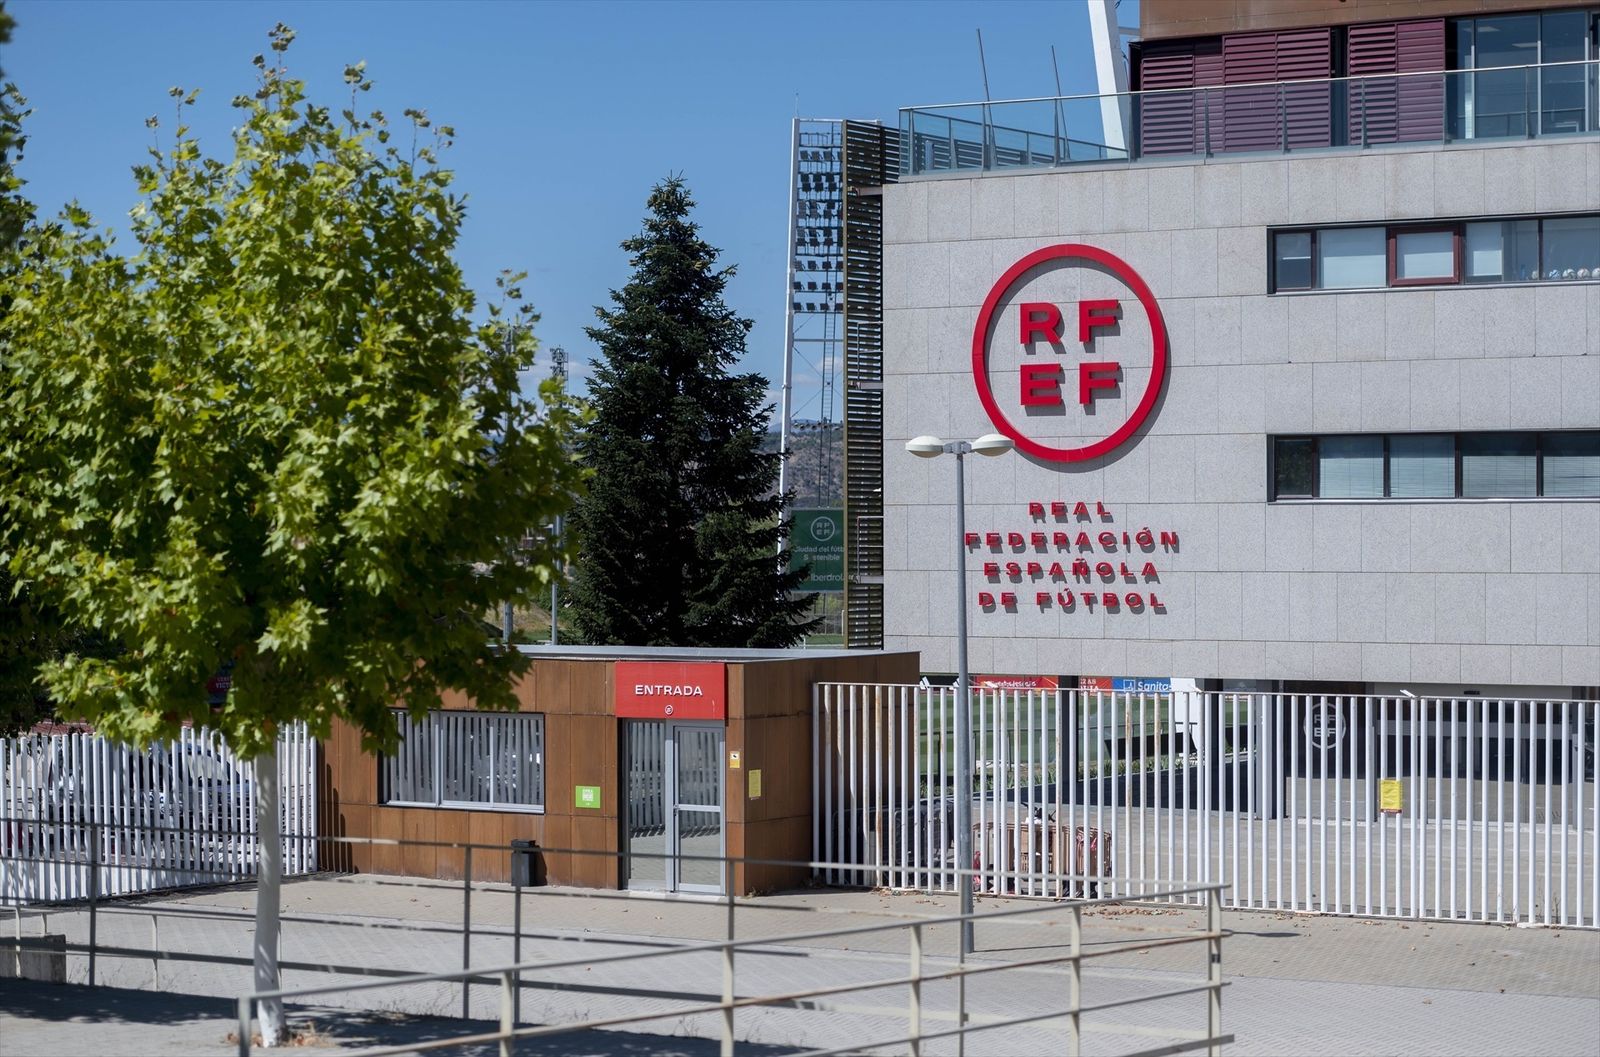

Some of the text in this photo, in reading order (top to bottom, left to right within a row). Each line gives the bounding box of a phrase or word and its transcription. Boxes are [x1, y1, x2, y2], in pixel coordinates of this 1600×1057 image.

[1020, 300, 1121, 345] RF
[1020, 362, 1121, 406] EF
[1029, 502, 1111, 516] REAL
[965, 527, 1177, 546] FEDERACIÓN
[984, 558, 1157, 576] ESPAÑOLA
[811, 573, 845, 582] Iberdrol
[978, 588, 1164, 608] DE FÚTBOL
[635, 684, 703, 696] ENTRADA
